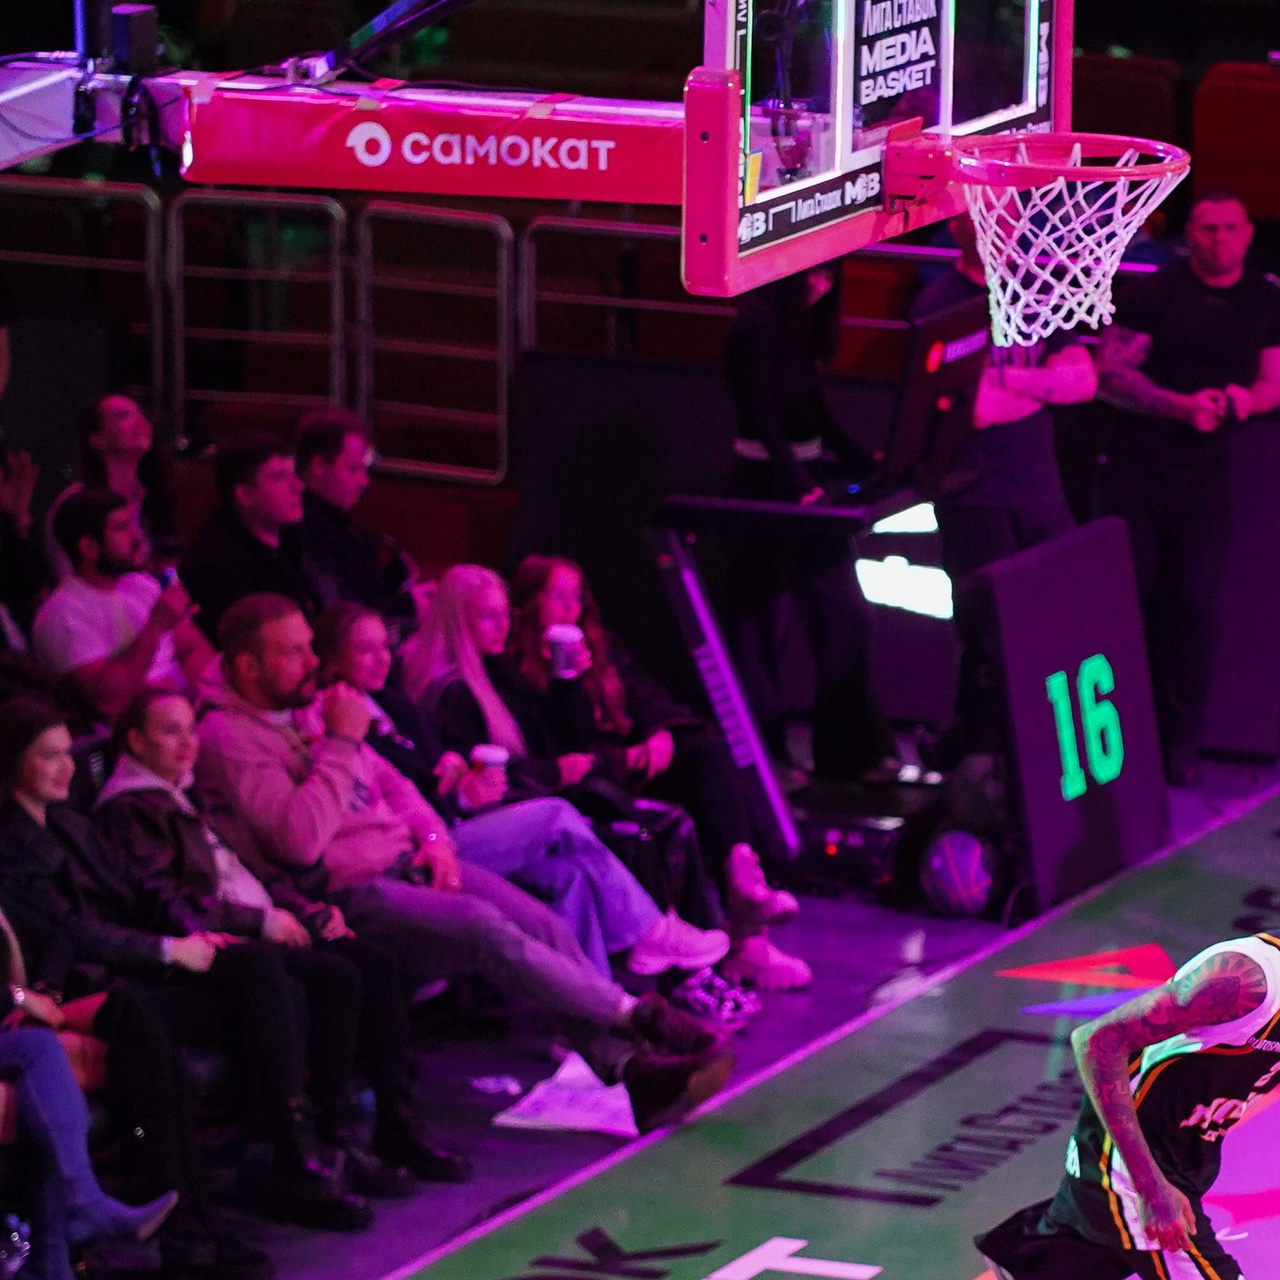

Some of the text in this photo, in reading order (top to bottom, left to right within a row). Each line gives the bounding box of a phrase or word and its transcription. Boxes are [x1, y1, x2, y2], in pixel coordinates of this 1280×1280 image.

[859, 26, 936, 77] MEDIA
[859, 59, 936, 106] BASKET
[1045, 652, 1124, 801] 16
